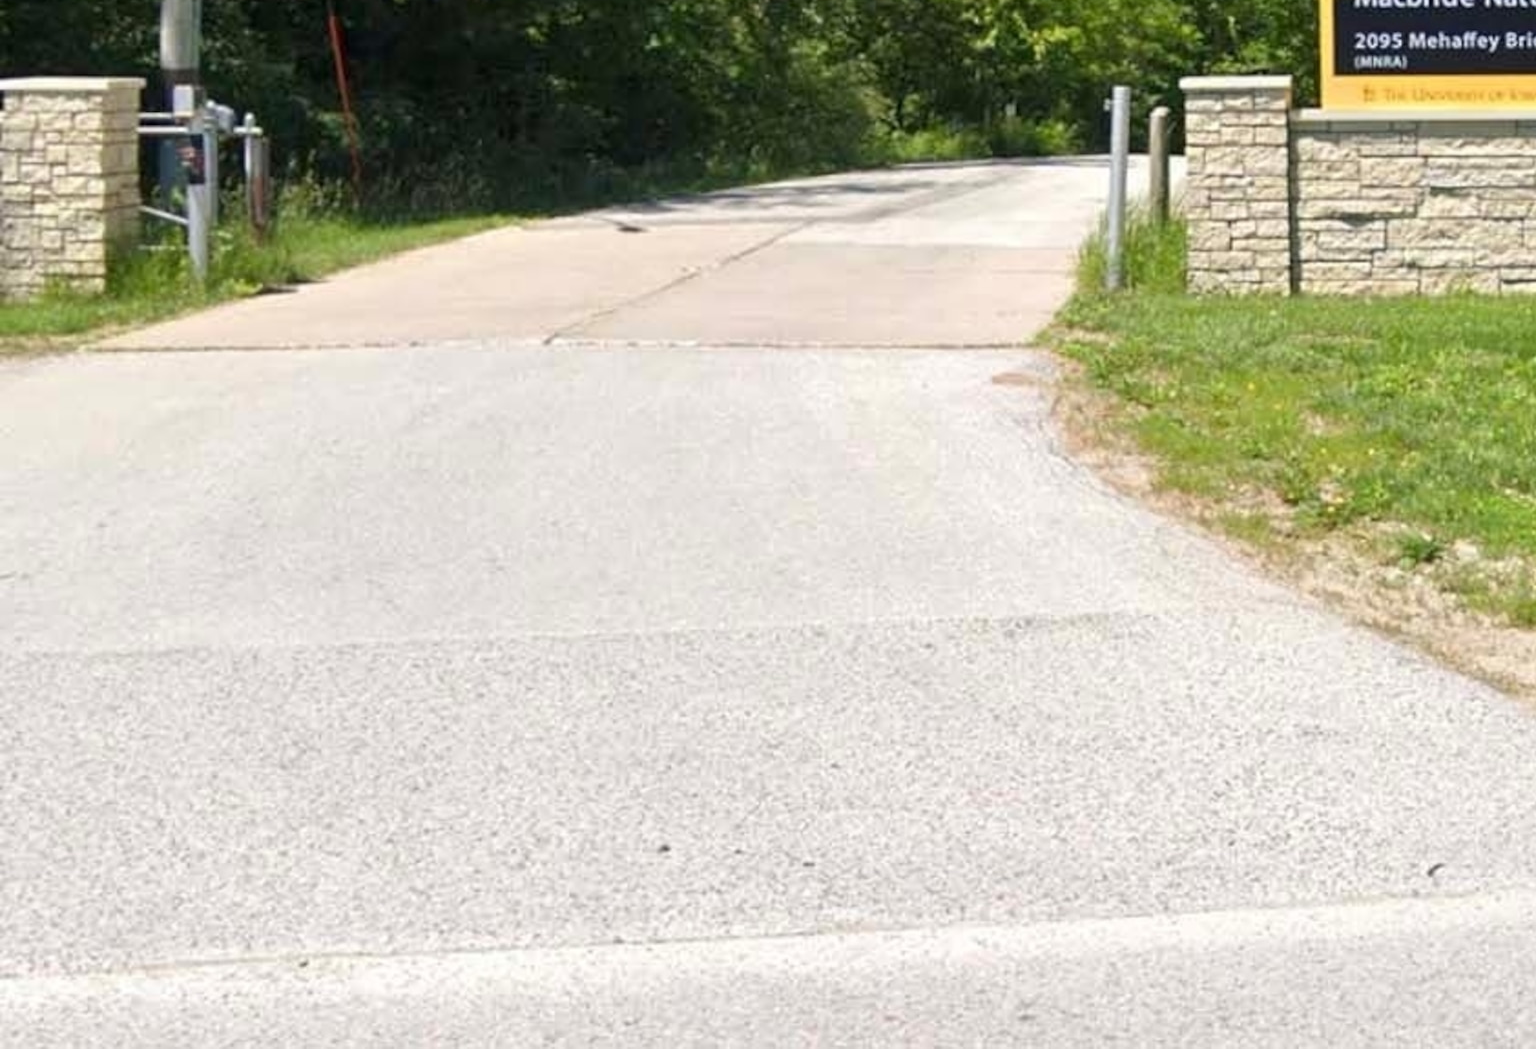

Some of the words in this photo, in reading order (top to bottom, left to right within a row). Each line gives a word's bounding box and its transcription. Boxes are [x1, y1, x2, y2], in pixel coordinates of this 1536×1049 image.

[1354, 32, 1403, 50] 2095
[1408, 31, 1500, 53] Mehaffey
[1354, 55, 1408, 70] (MNRA)
